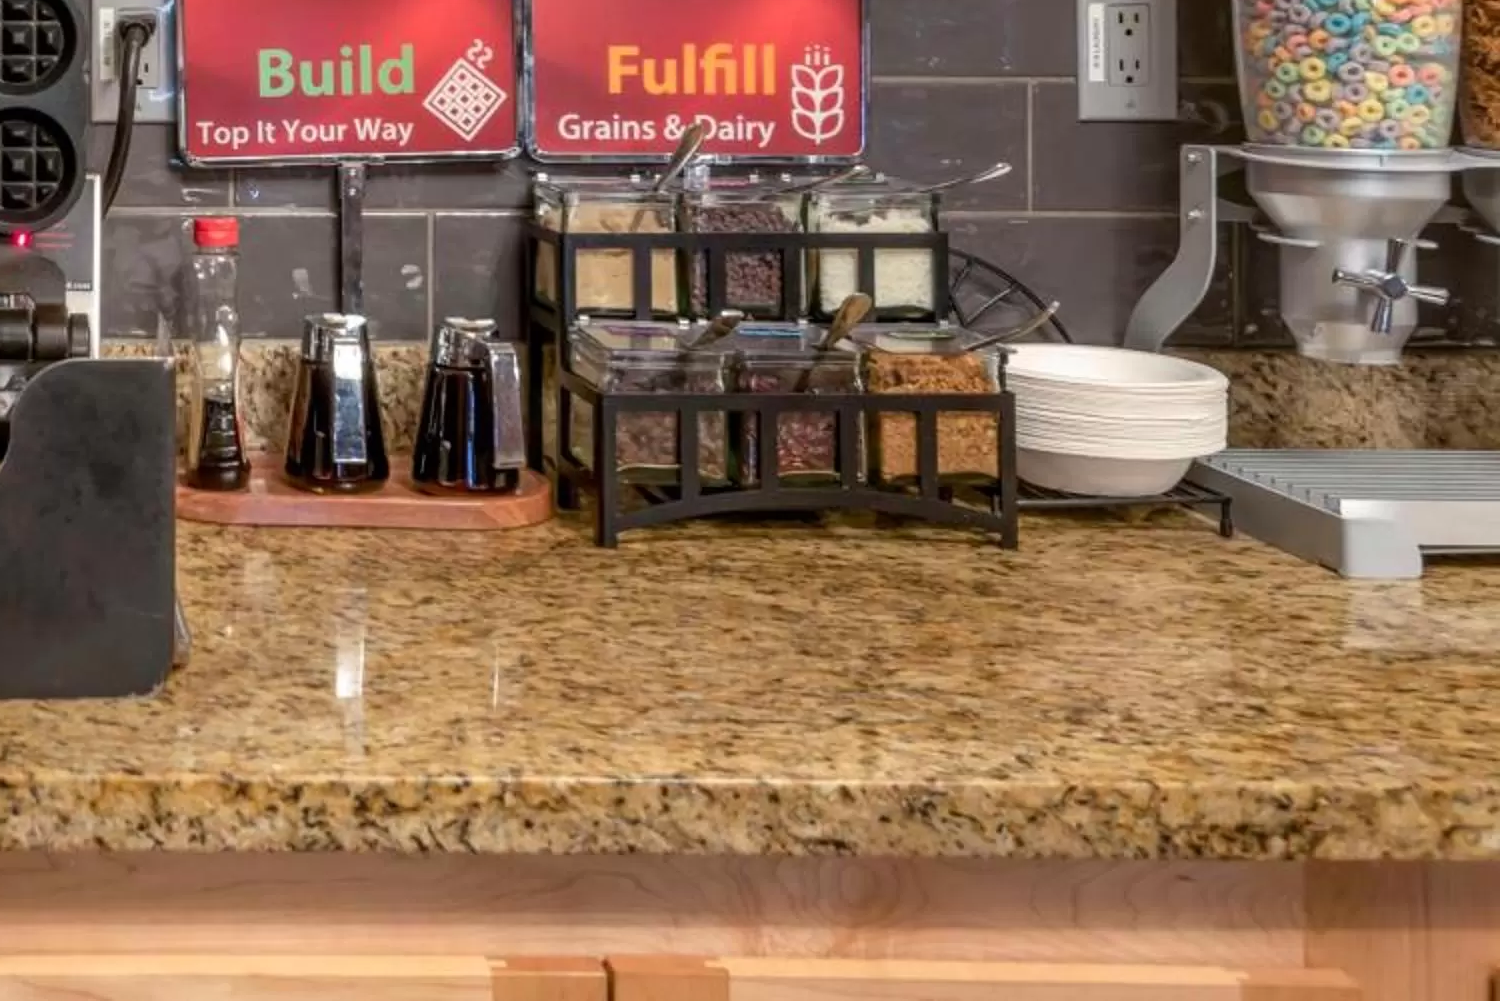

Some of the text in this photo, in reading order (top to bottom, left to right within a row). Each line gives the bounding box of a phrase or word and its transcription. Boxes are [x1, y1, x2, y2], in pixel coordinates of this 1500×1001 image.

[257, 43, 416, 98] Build
[607, 43, 776, 95] Fulfill
[196, 118, 414, 150] Top It Your Way
[558, 114, 776, 148] Grains & Dairy
